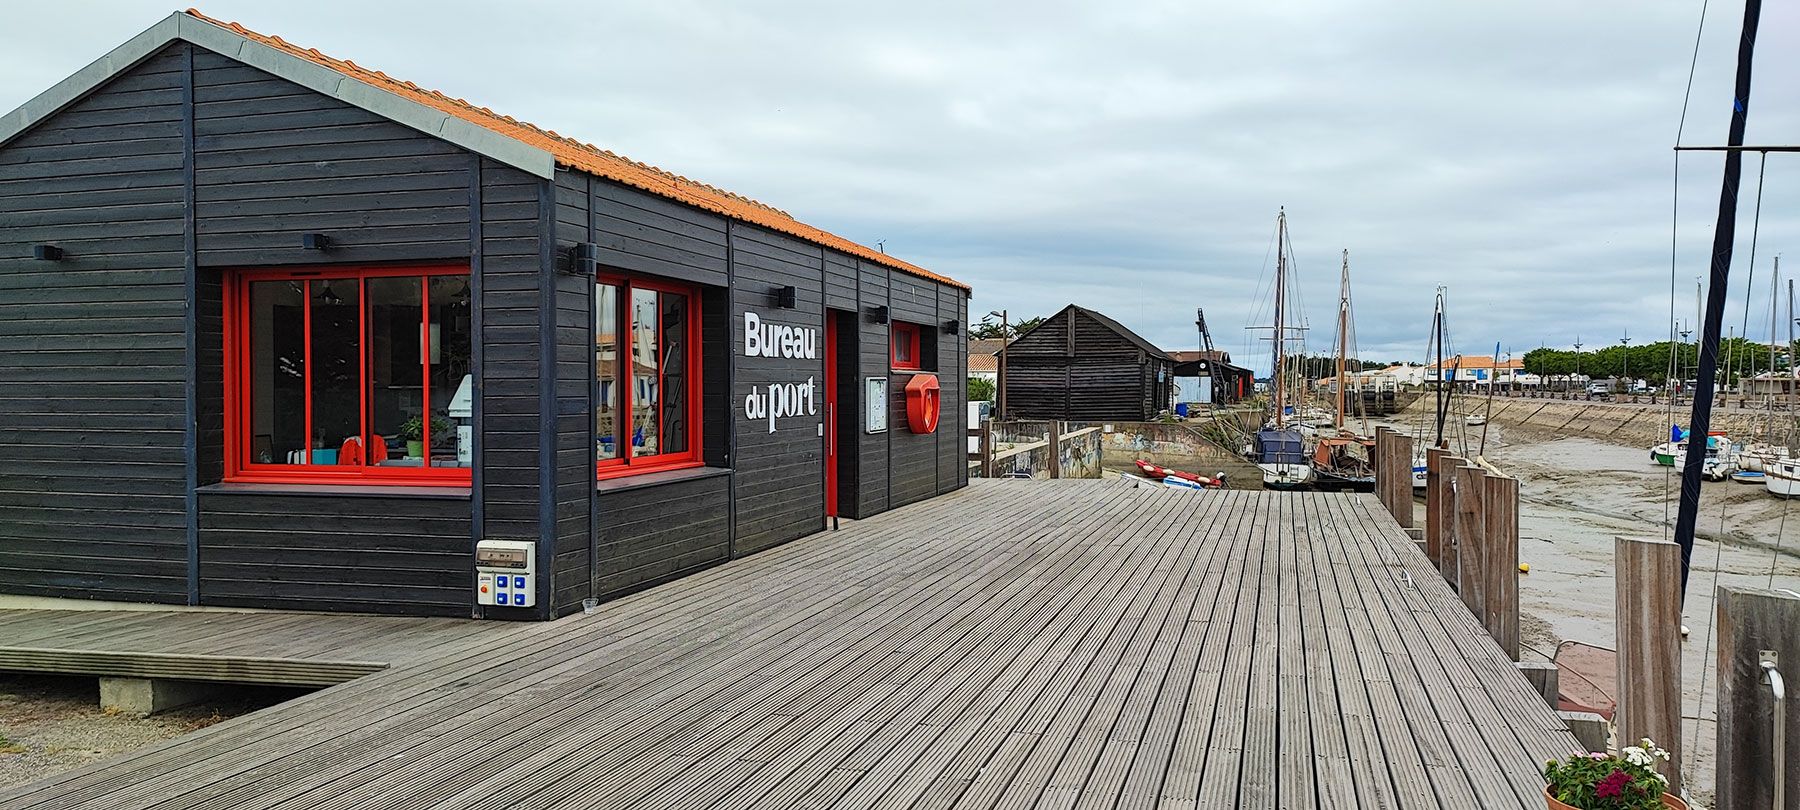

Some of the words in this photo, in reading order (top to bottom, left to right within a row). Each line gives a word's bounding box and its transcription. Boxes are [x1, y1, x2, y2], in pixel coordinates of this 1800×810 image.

[744, 311, 816, 359] Bureau
[745, 386, 766, 419] du
[768, 375, 816, 434] port
